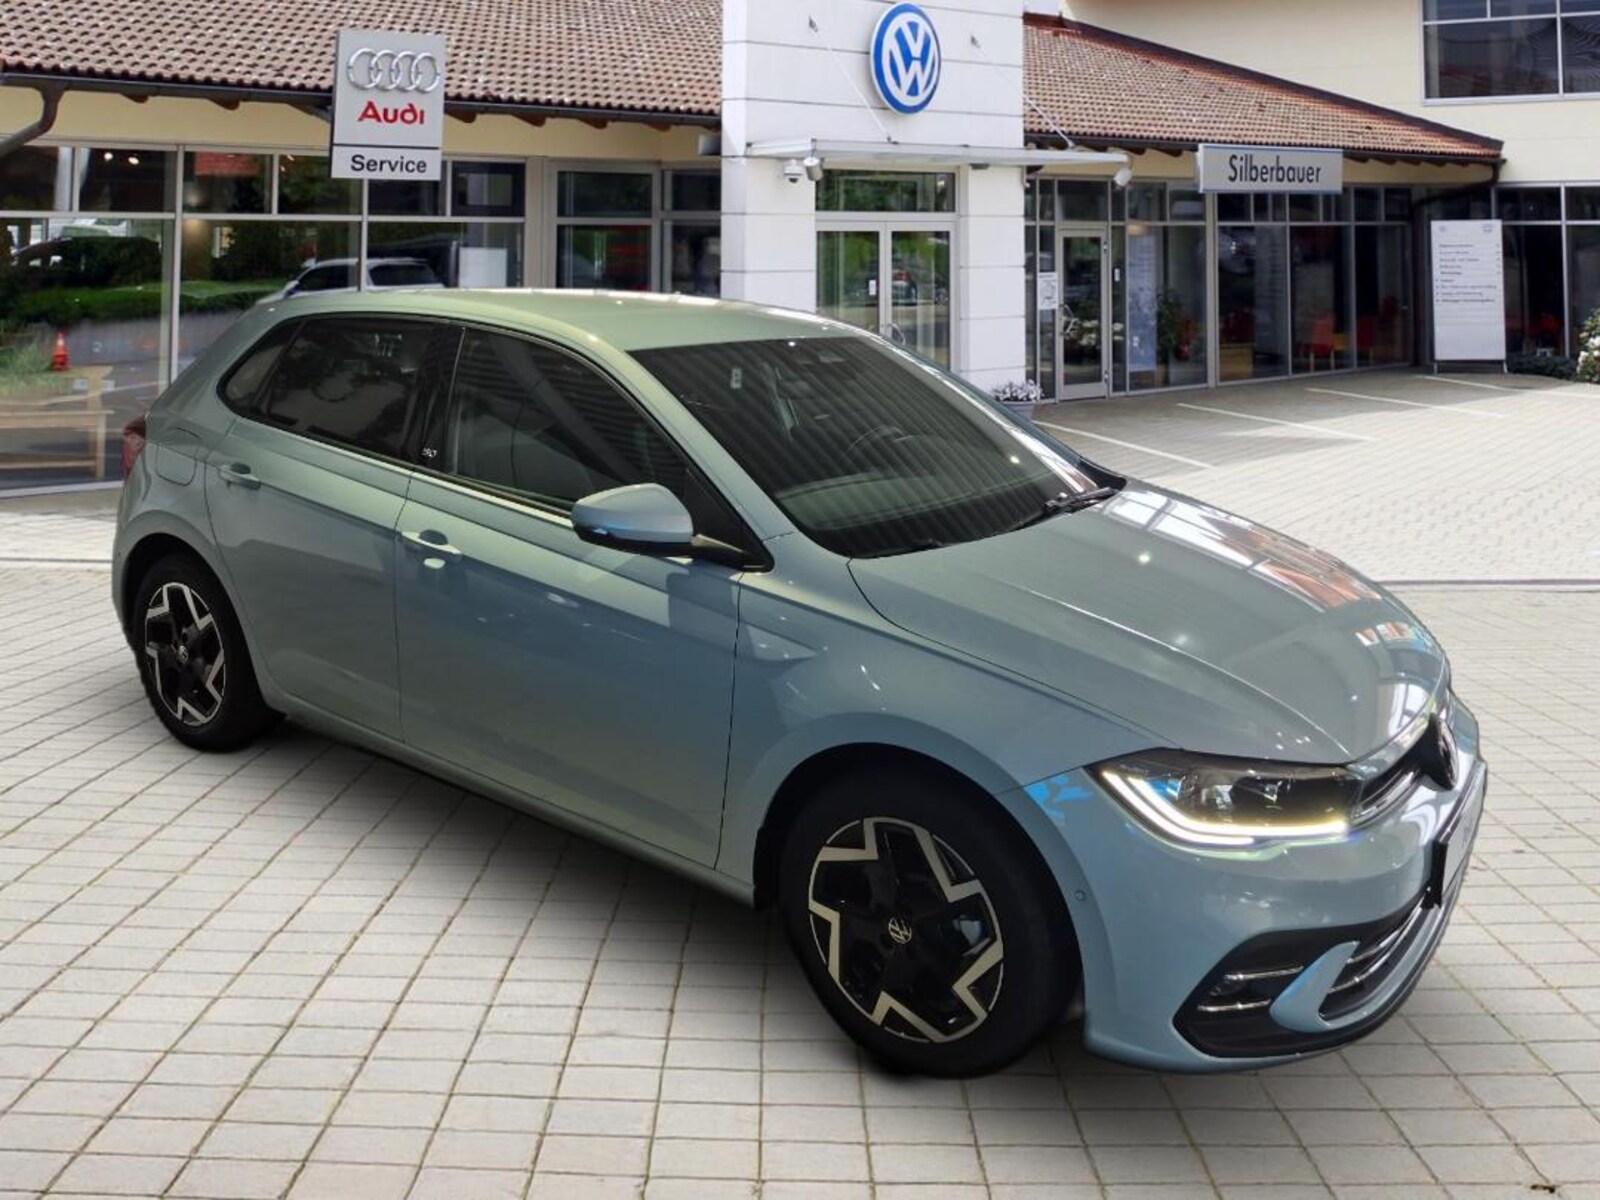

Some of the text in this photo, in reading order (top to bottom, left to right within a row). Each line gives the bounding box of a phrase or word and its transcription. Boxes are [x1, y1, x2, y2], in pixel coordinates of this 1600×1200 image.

[876, 7, 940, 110] VW
[357, 100, 424, 125] Audi
[350, 154, 427, 173] Service
[1228, 154, 1321, 183] Silberbauer
